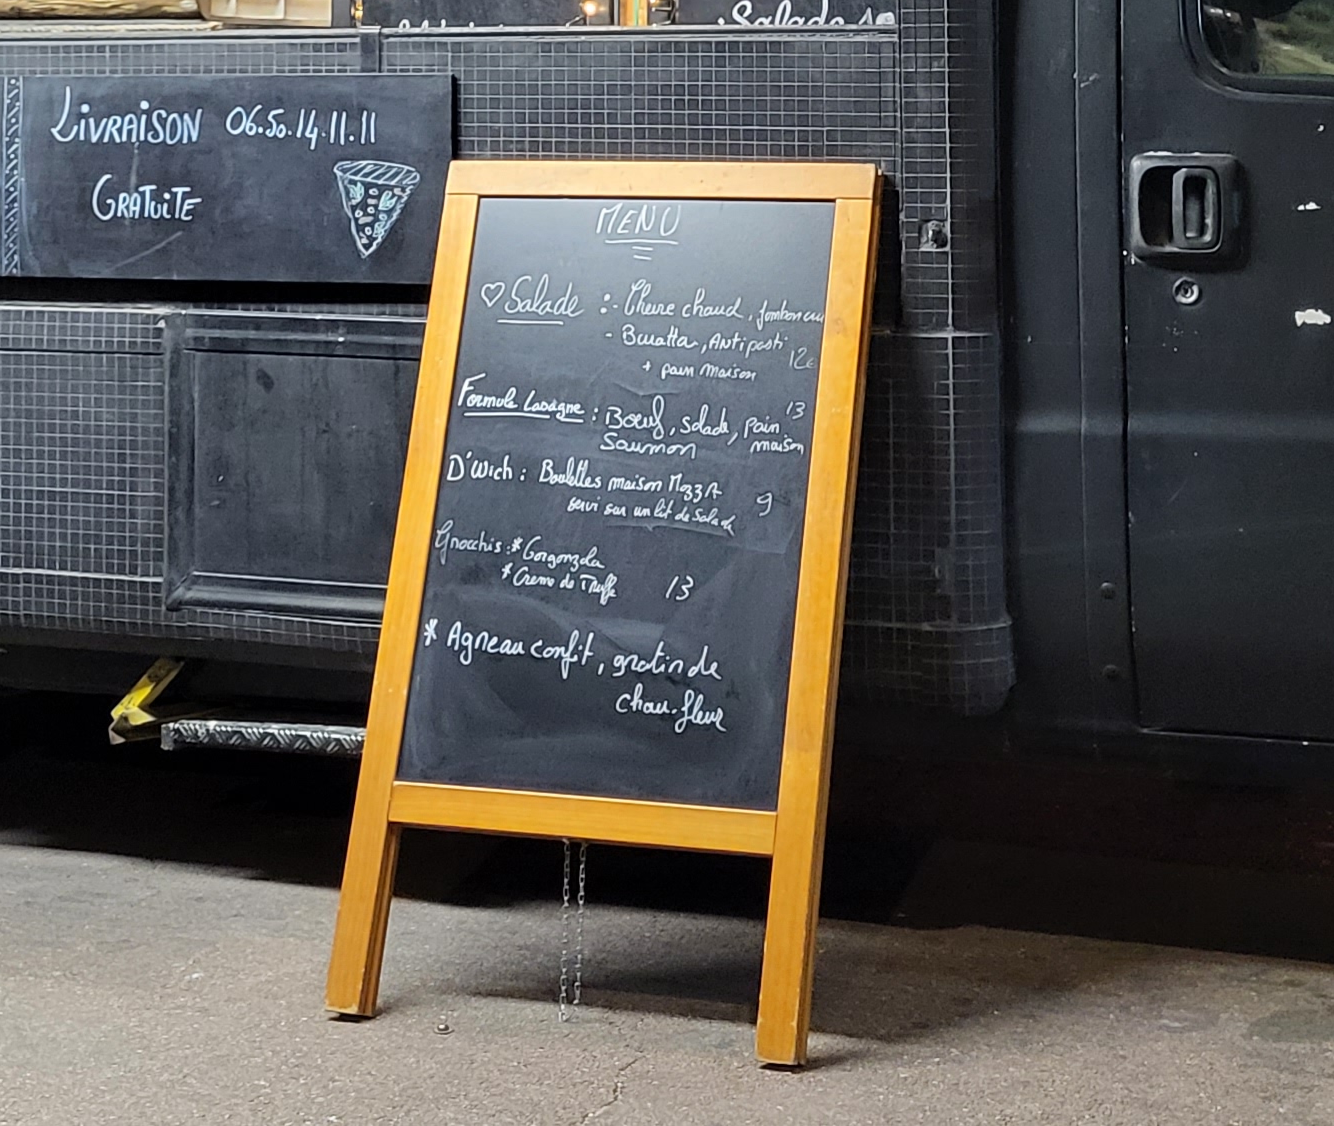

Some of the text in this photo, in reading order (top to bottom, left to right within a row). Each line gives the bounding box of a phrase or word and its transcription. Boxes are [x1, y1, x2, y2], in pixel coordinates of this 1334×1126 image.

[224, 104, 378, 151] 06.50.14.11.11
[595, 202, 682, 237] MENU
[503, 273, 586, 319] Salade
[698, 361, 758, 382] maison
[457, 373, 519, 409] Formule
[743, 415, 781, 440] pain
[784, 400, 807, 422] 13
[598, 431, 806, 460] Saumon maison
[538, 456, 603, 491] Boulettes
[607, 474, 663, 493] maison
[633, 505, 653, 518] un
[674, 504, 693, 522] de
[755, 491, 775, 518] 9
[665, 574, 696, 602] 13
[446, 620, 723, 680] Agneau gratin de
